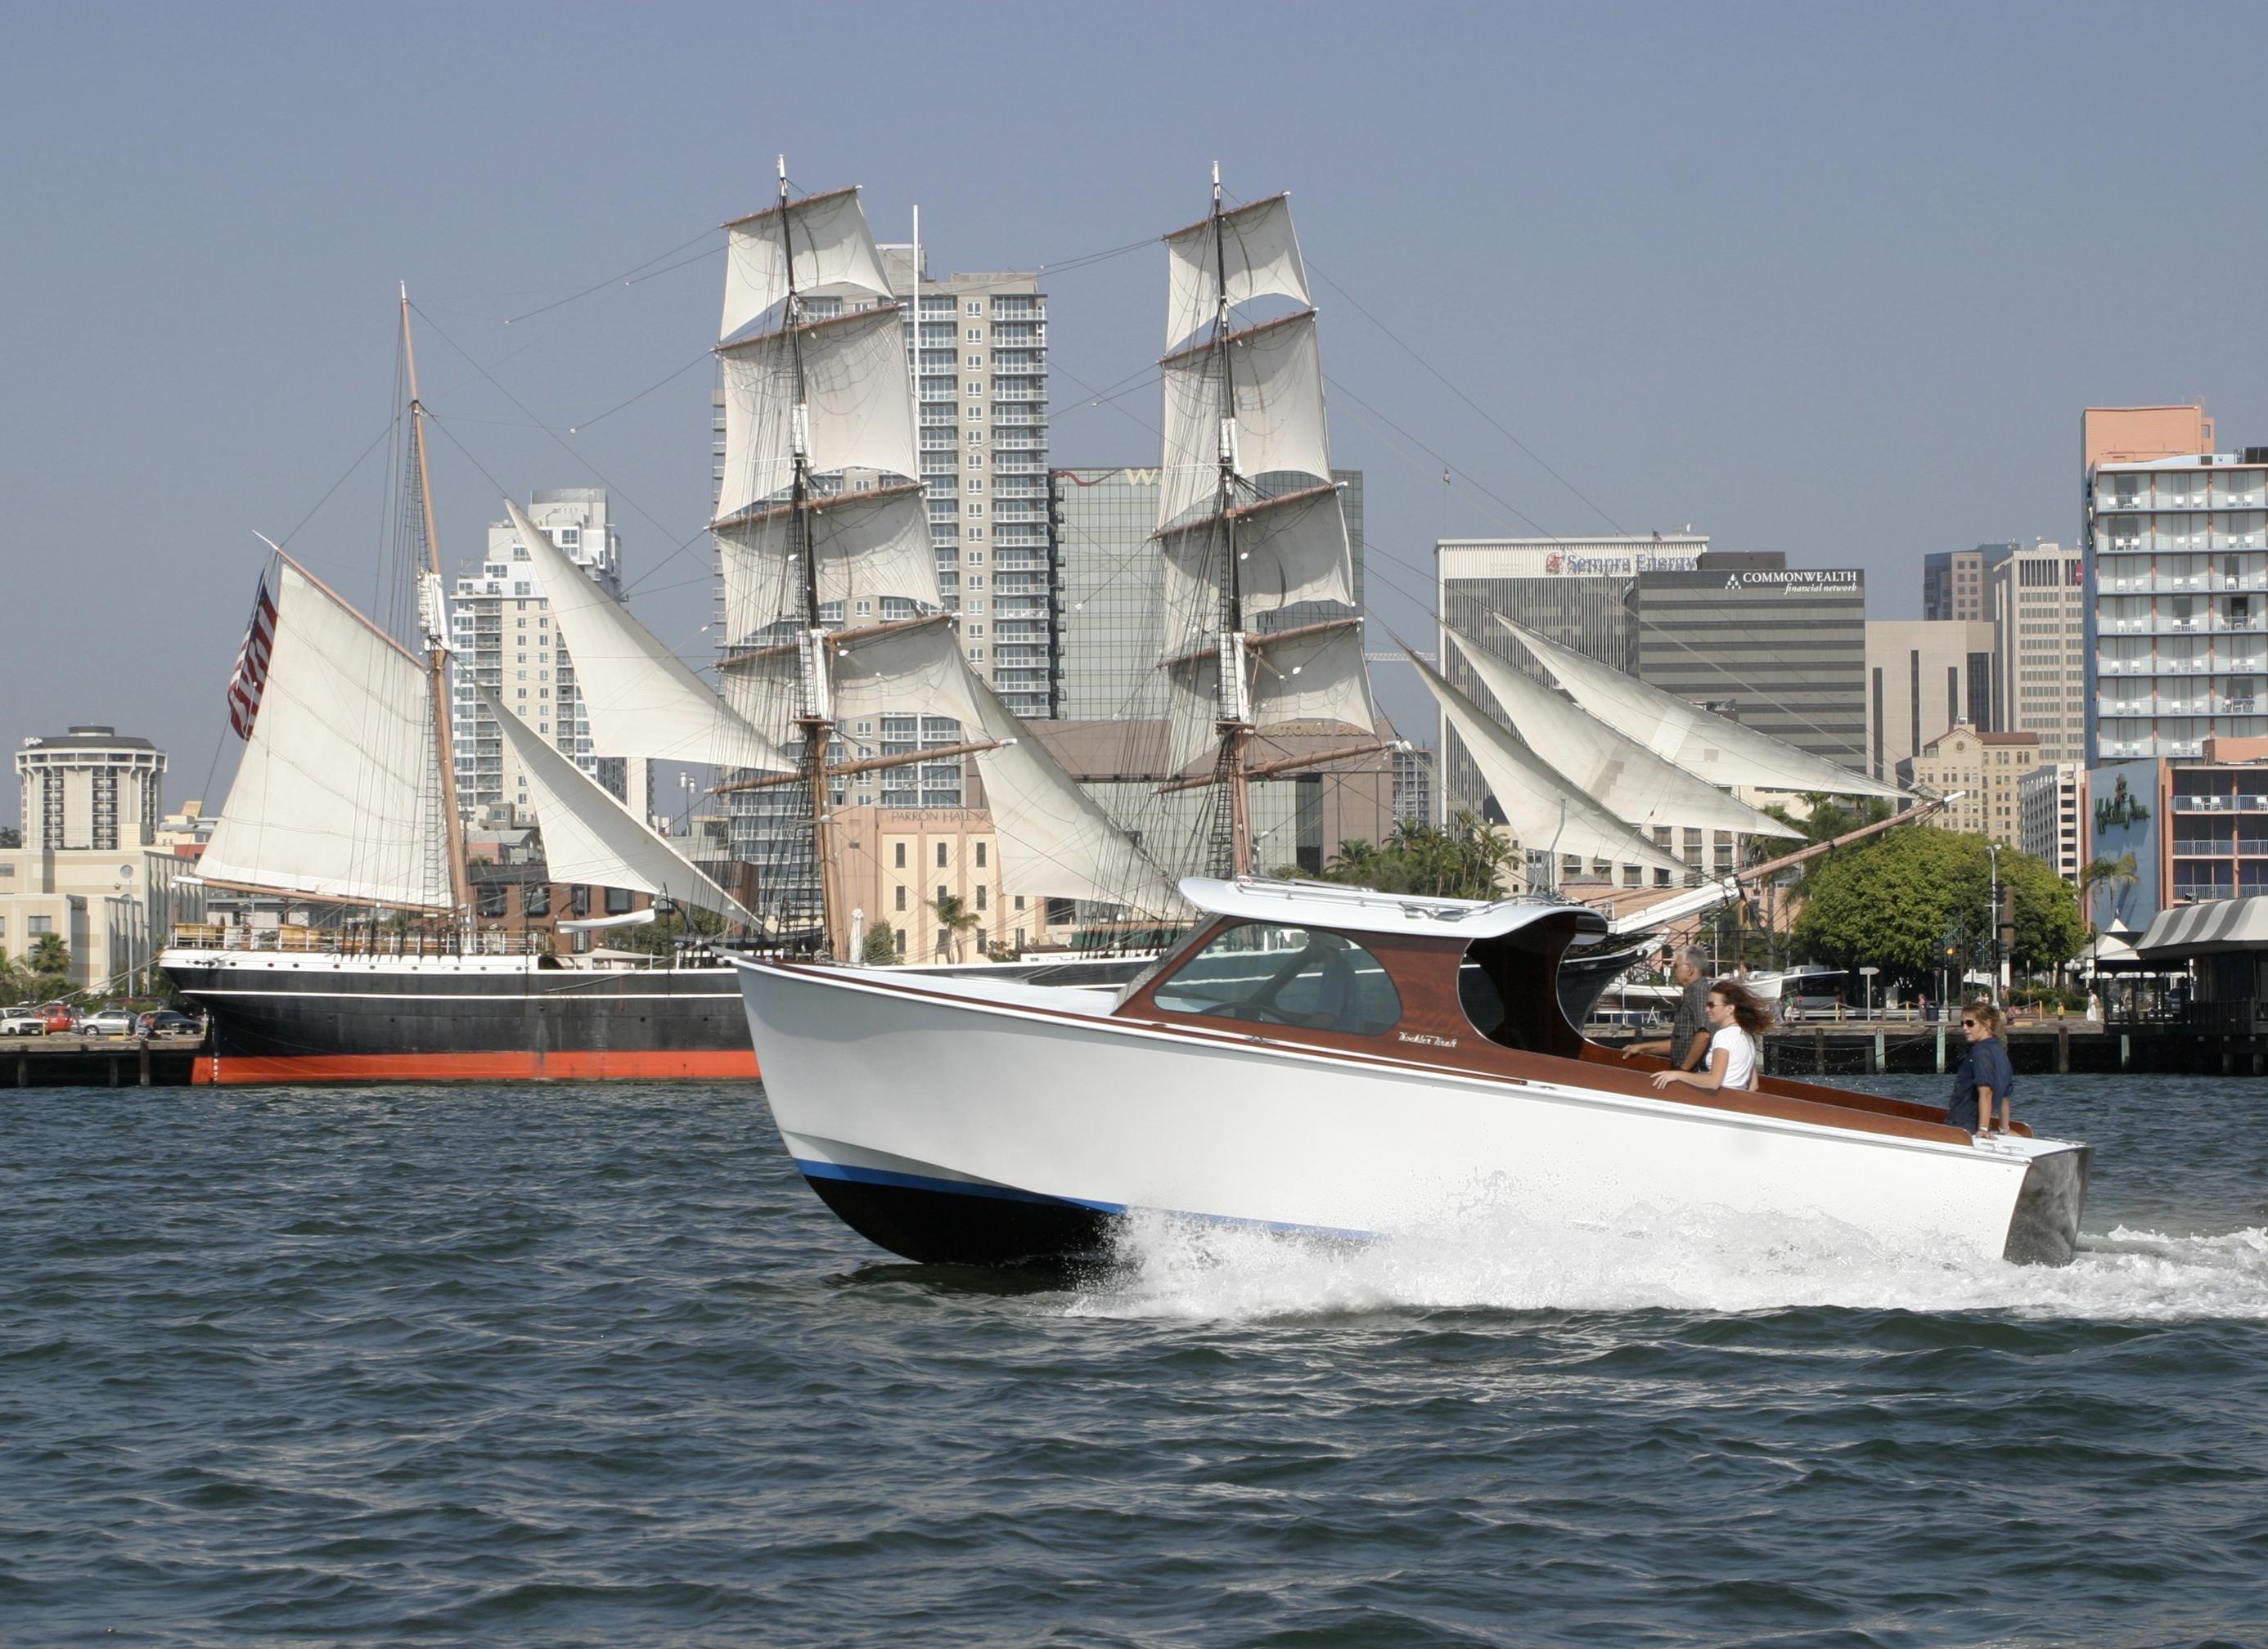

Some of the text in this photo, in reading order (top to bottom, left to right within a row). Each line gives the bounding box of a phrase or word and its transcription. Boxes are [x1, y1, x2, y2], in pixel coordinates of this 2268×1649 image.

[1124, 468, 1163, 486] W
[1567, 555, 1631, 576] Sempra
[1742, 571, 1856, 583] COMMONWEALTH
[1784, 582, 1857, 595] financial network
[891, 811, 938, 824] PARRON
[943, 811, 974, 823] HALL
